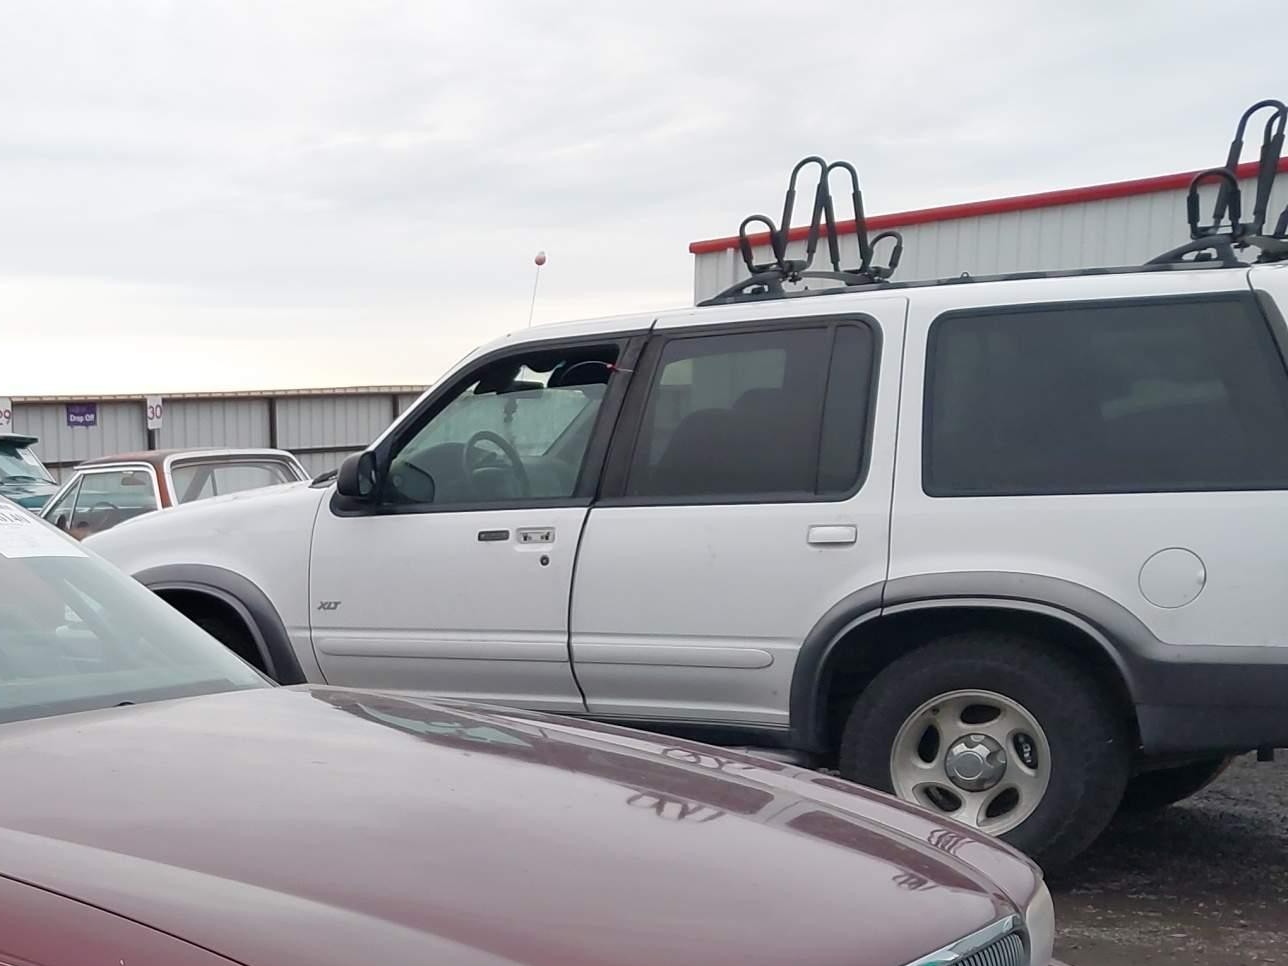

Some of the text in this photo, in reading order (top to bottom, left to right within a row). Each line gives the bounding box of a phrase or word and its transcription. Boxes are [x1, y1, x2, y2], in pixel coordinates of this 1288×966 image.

[147, 404, 162, 420] 30
[69, 413, 95, 423] Drop Off
[317, 601, 342, 610] XLT
